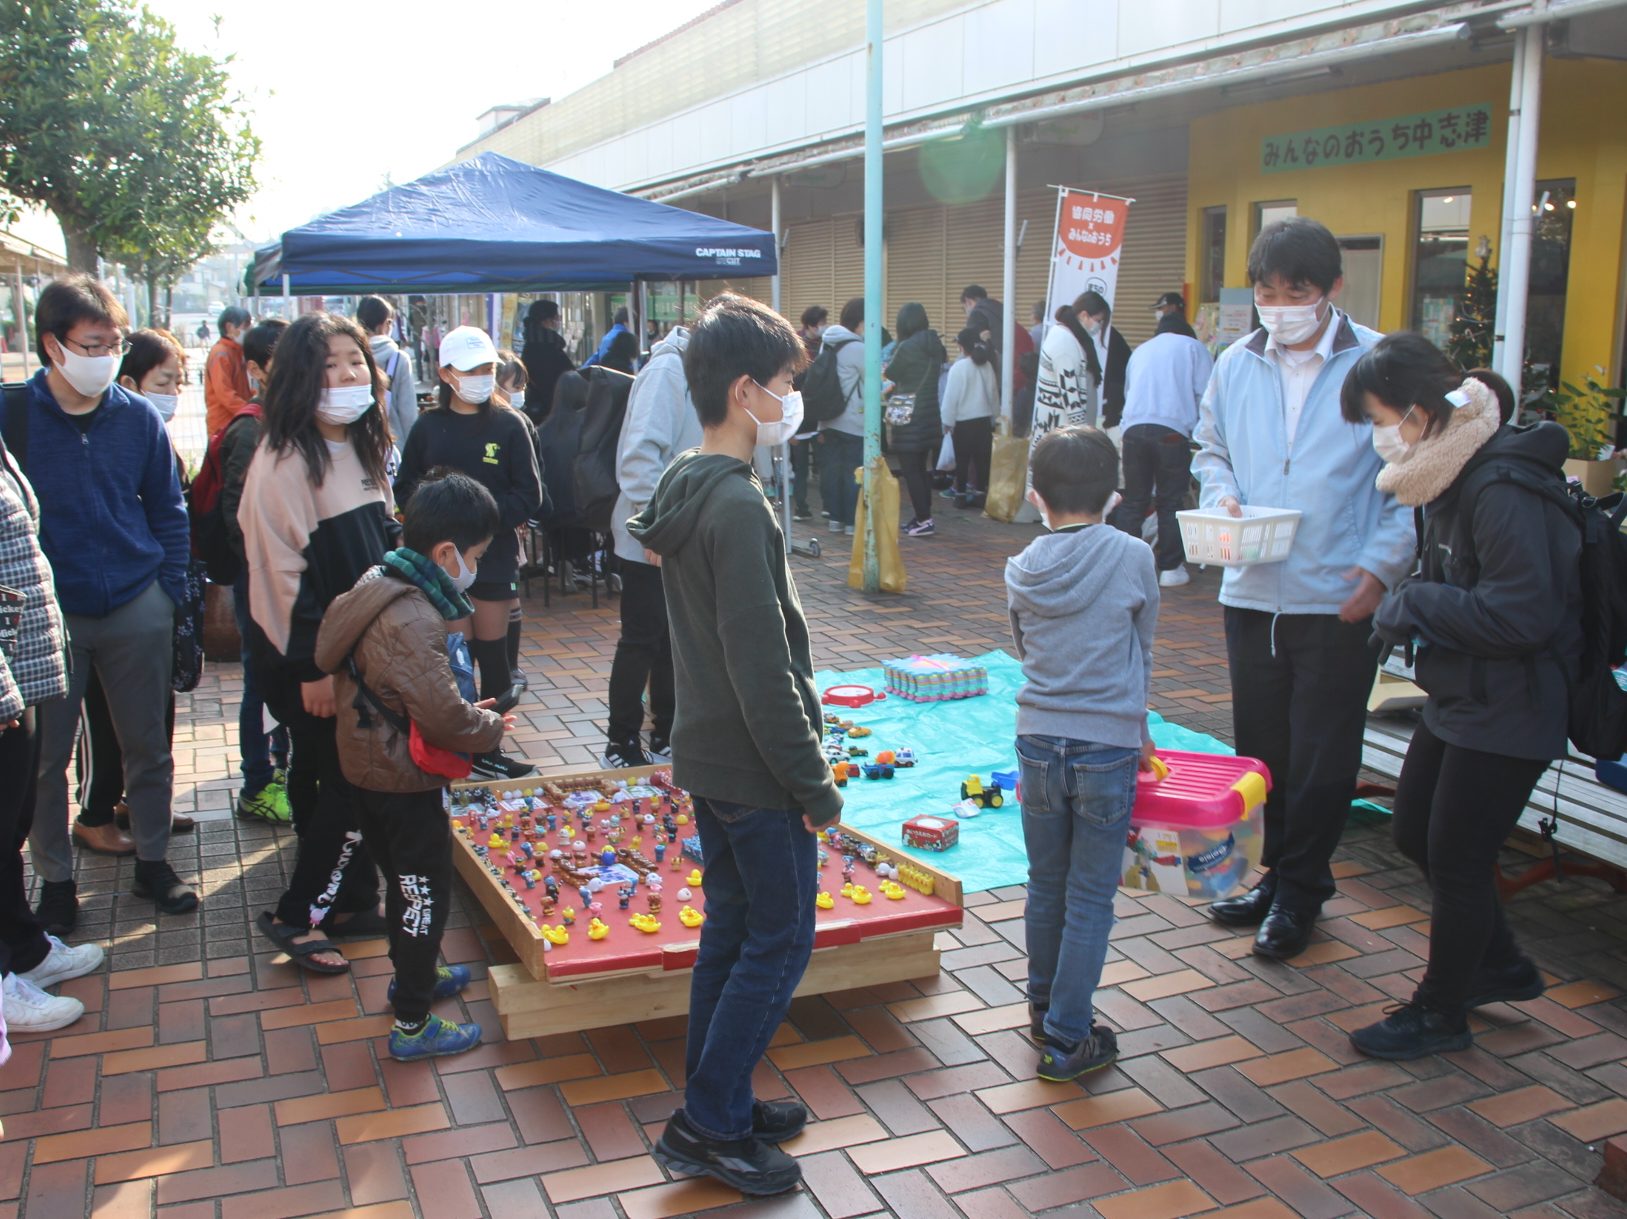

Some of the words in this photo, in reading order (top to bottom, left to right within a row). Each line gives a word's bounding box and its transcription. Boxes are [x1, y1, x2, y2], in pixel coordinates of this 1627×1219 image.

[1263, 109, 1489, 167] みんなのおうち中志津
[695, 247, 736, 257] CAPTAIN
[737, 249, 761, 258] STAG
[398, 874, 422, 937] RESPECT
[419, 908, 432, 935] GREAT
